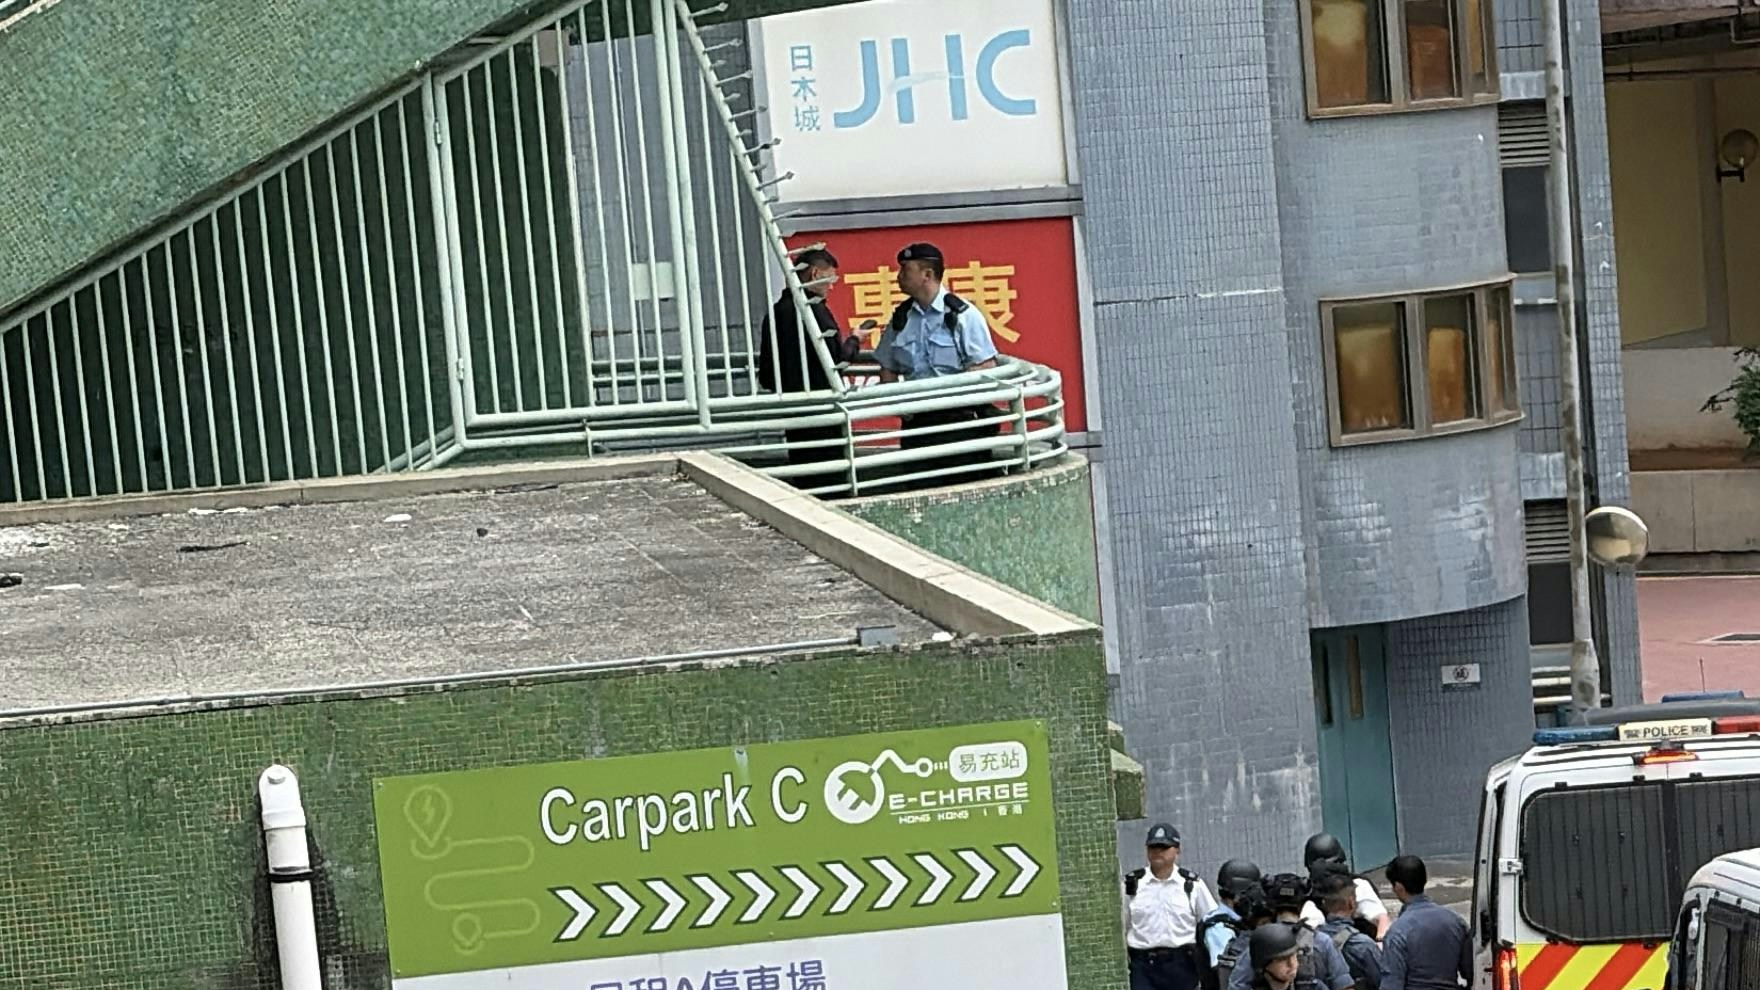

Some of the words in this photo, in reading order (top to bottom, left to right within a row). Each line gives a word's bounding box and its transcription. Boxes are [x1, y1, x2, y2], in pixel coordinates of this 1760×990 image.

[833, 29, 1037, 129] JHC
[1643, 725, 1689, 738] POLICE
[958, 748, 1020, 773] 易充站
[541, 774, 755, 849] Carpark
[771, 768, 808, 822] C
[889, 782, 1029, 810] E-CHARGE
[899, 815, 931, 824] HONG
[938, 810, 969, 821] KONG
